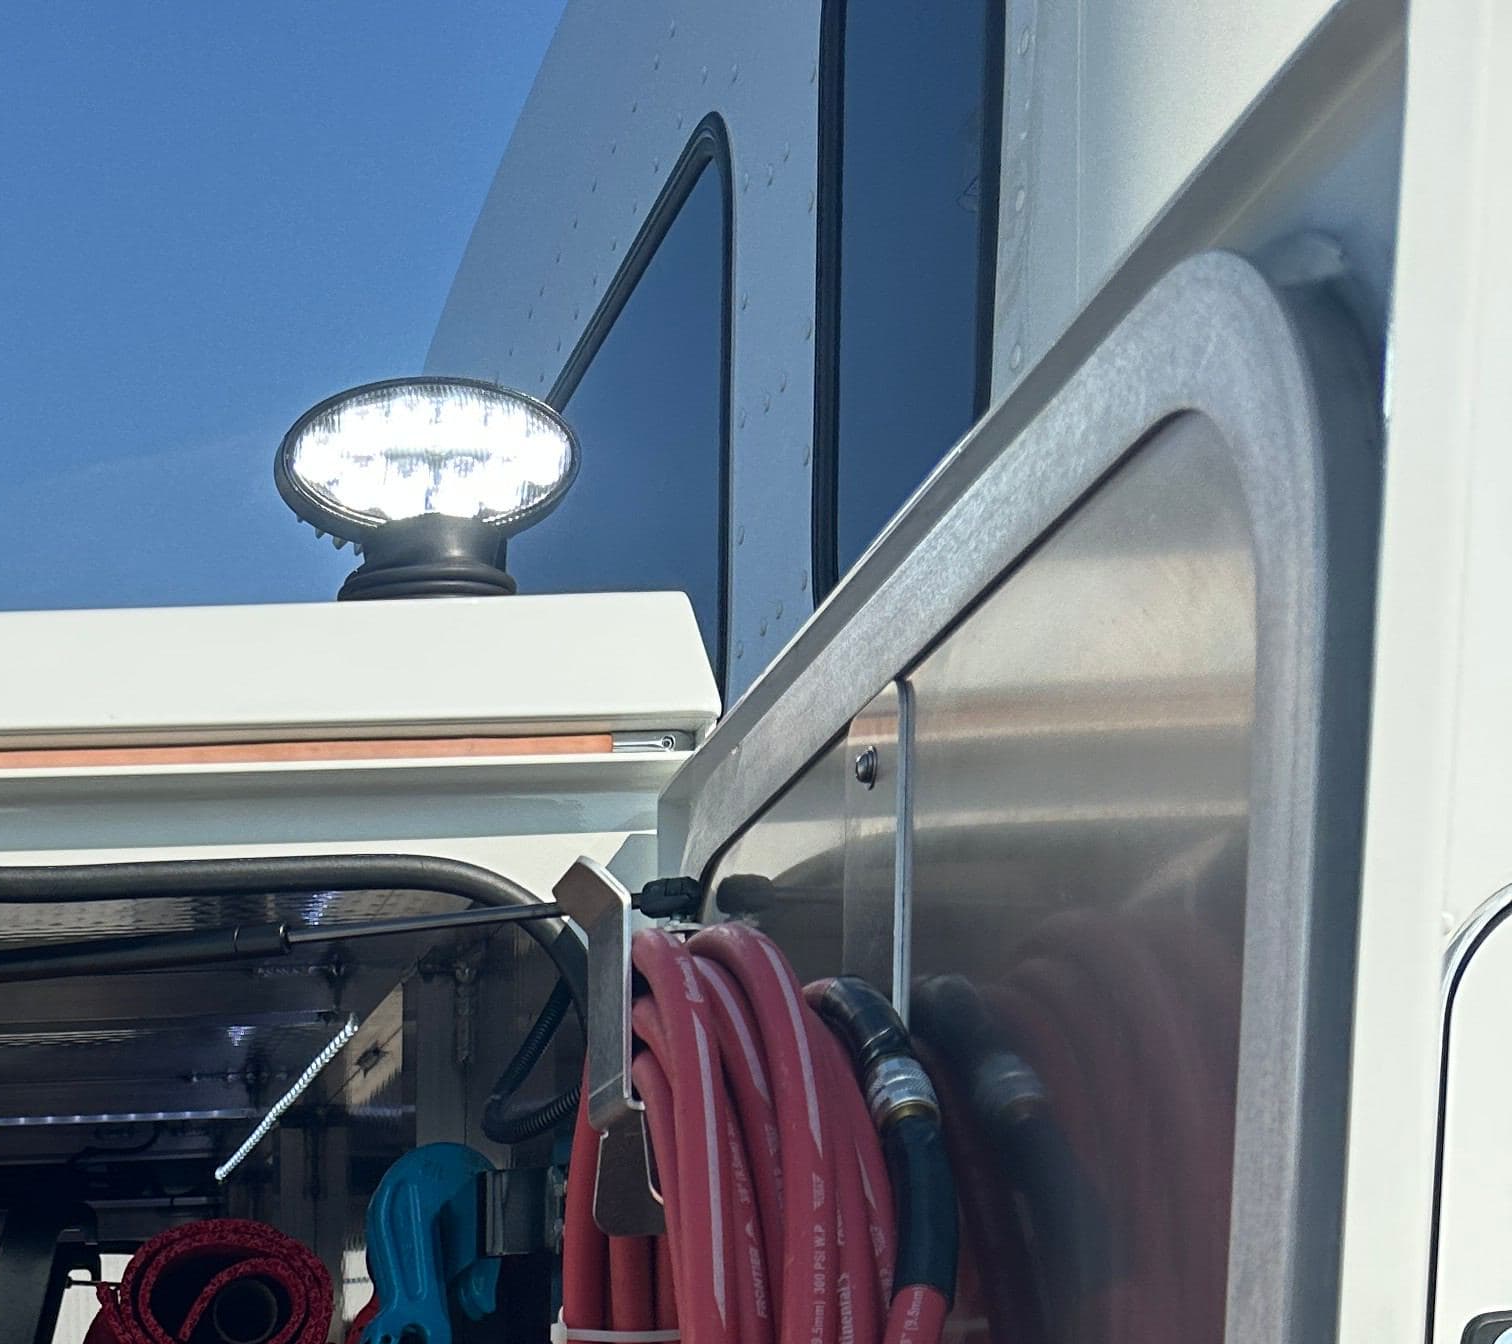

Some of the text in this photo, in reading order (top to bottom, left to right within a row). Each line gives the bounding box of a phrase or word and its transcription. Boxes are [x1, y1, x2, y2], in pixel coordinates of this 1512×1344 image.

[814, 1250, 825, 1270] PSI
[749, 1247, 768, 1319] FRONTIER
[812, 1274, 825, 1294] 300
